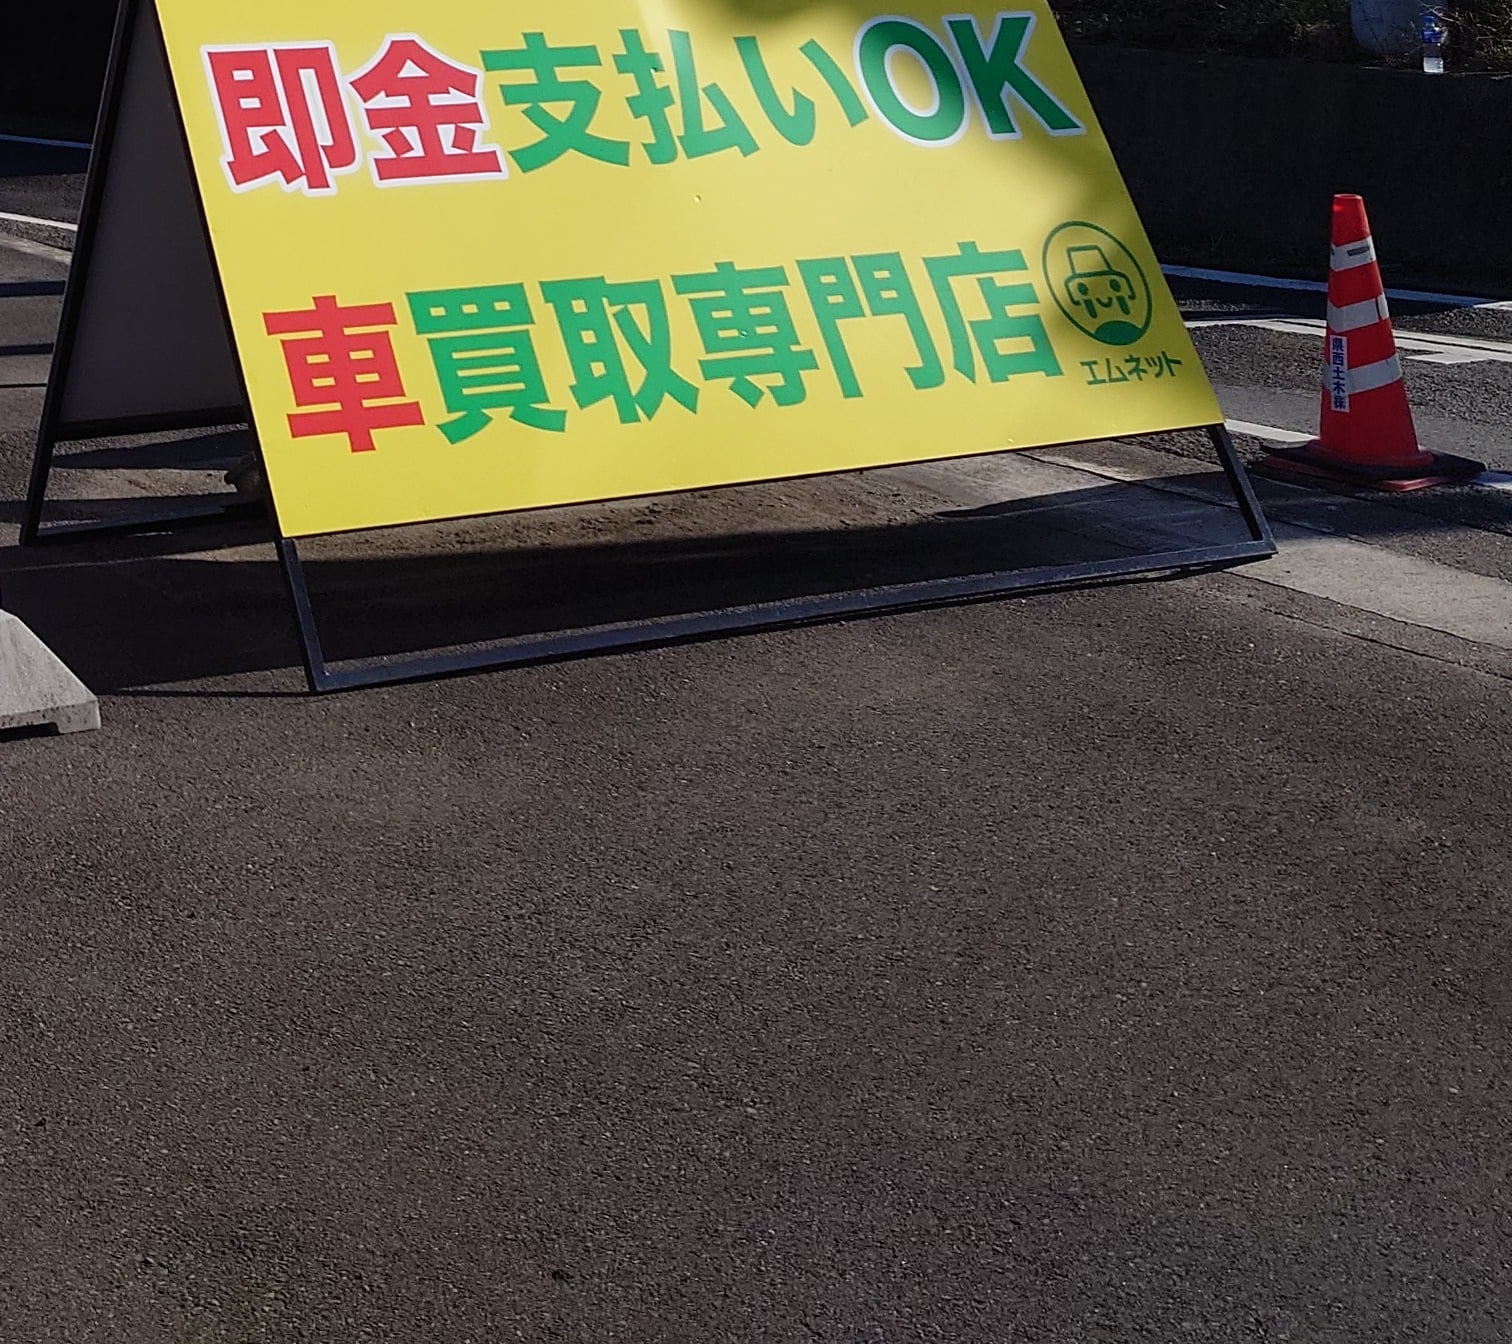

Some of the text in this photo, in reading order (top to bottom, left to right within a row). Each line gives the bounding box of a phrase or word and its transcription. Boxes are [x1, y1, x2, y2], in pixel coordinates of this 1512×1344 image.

[200, 10, 1085, 196] 即金支払いOK
[263, 240, 1064, 454] 車買取専門店
[1080, 350, 1183, 385] エムネット
